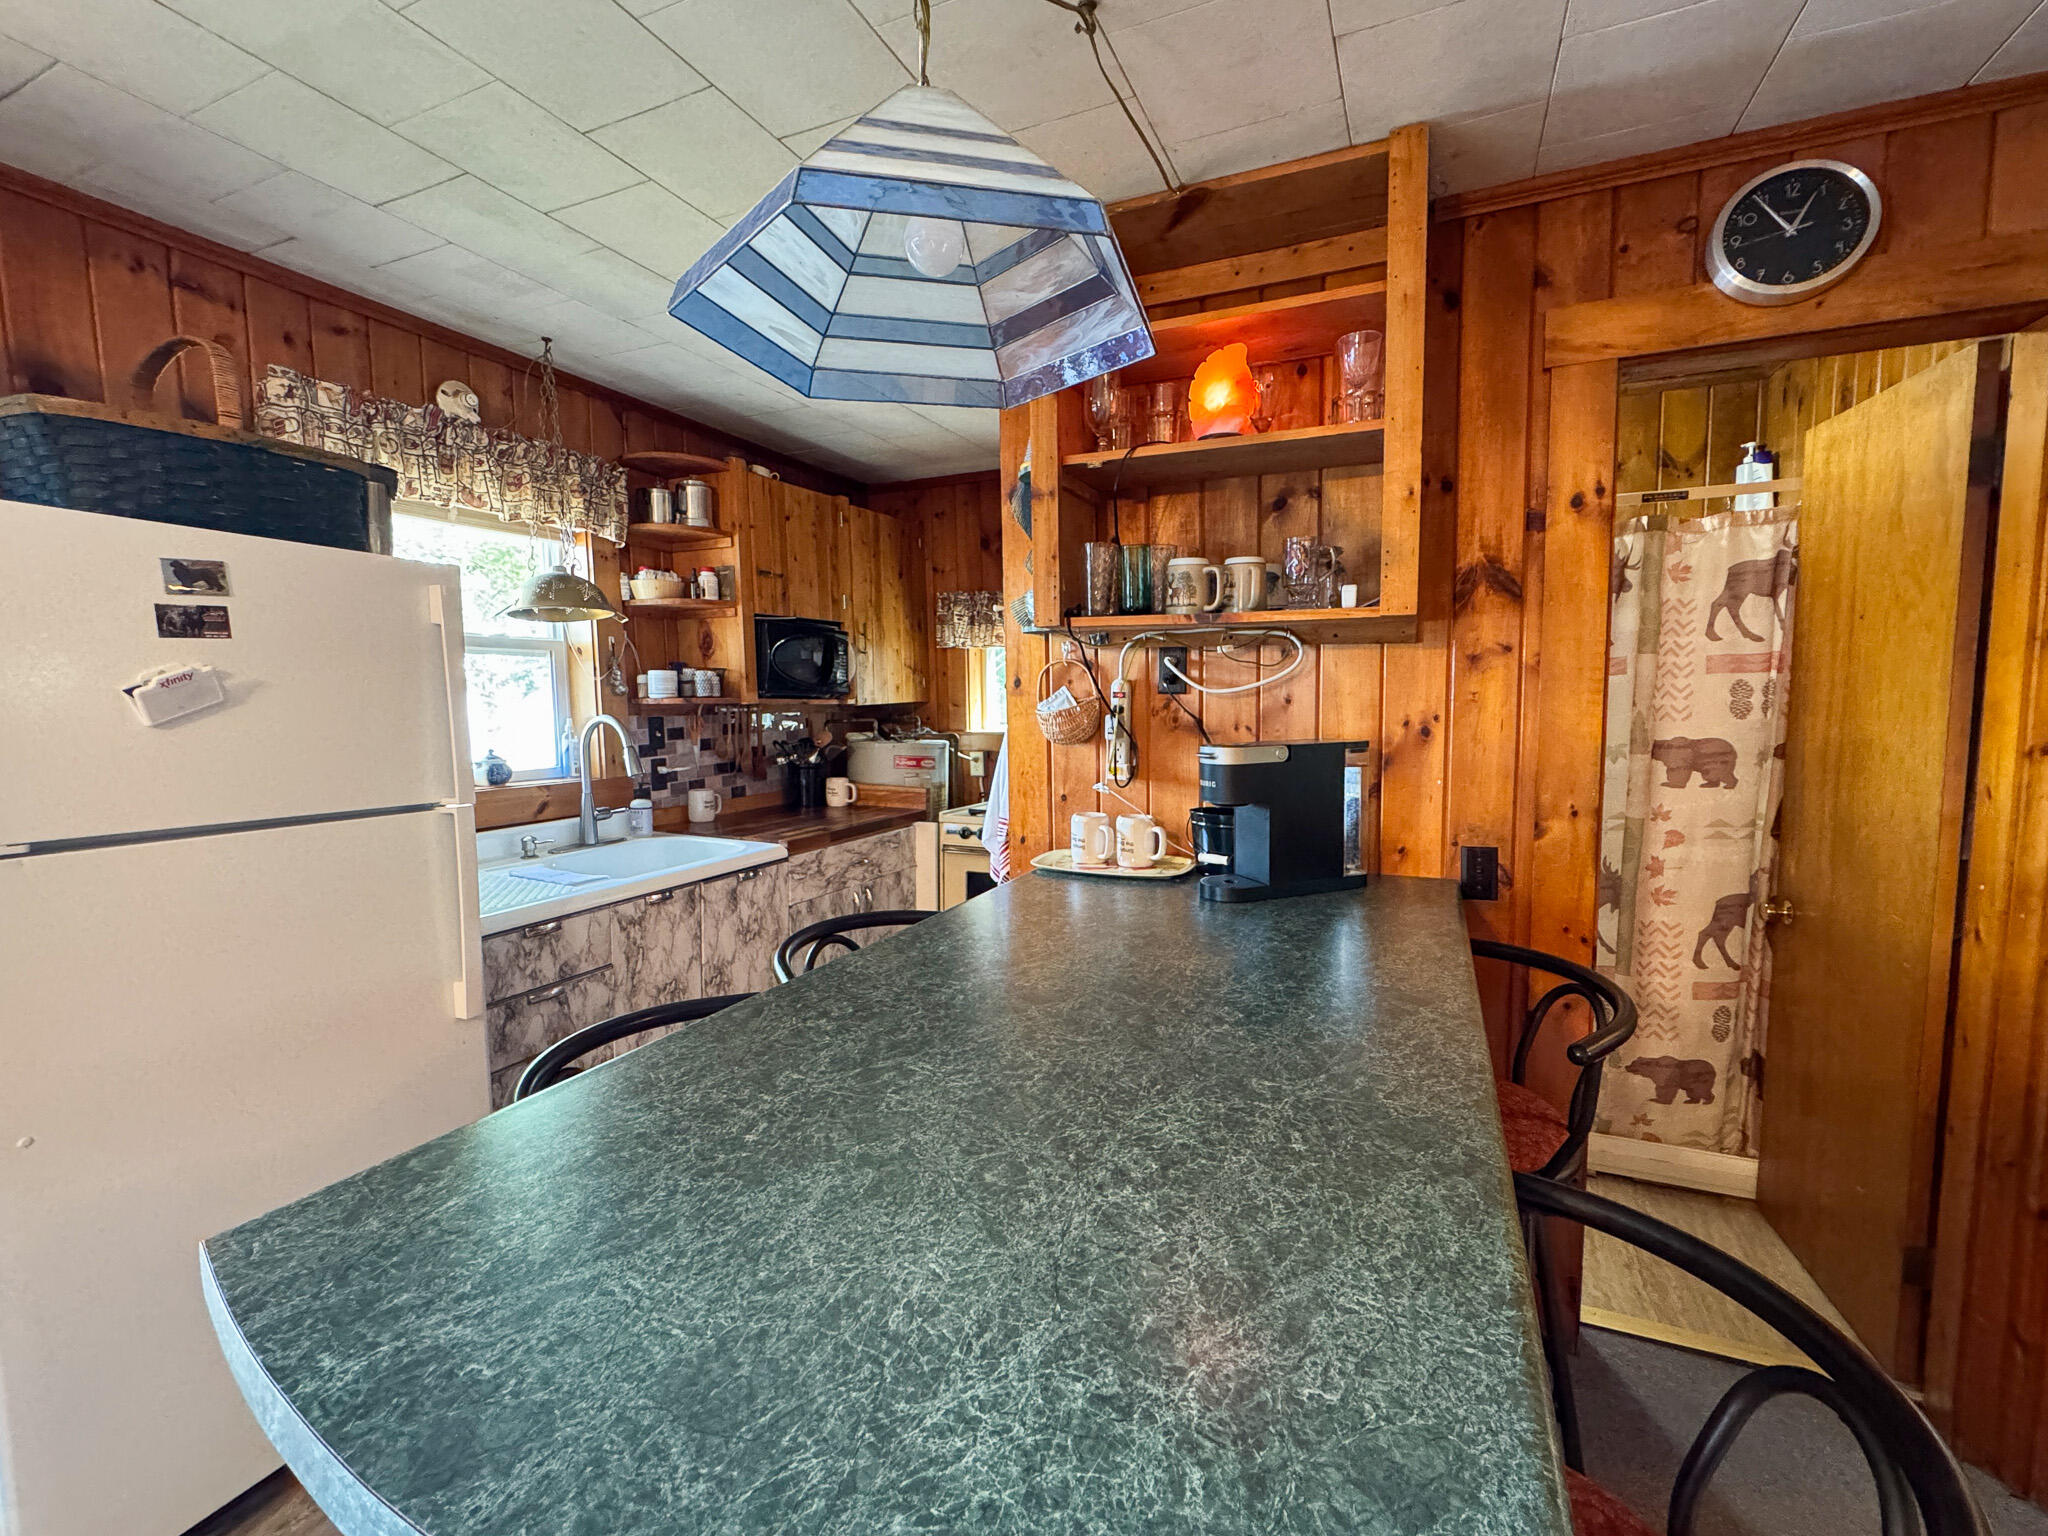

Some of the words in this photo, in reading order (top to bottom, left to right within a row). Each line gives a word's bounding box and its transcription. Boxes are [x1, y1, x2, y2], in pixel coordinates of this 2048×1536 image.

[1785, 182, 1801, 197] 12
[1819, 184, 1827, 196] 1
[1838, 197, 1849, 210] 2
[1736, 213, 1758, 227] 10
[1841, 217, 1854, 230] 3
[1730, 235, 1742, 249] 9
[1834, 241, 1845, 253] 4
[1735, 257, 1746, 270] 8
[1812, 260, 1823, 274] 5
[1756, 268, 1766, 281] 7
[1782, 271, 1795, 283] 6
[159, 671, 194, 688] xfinity
